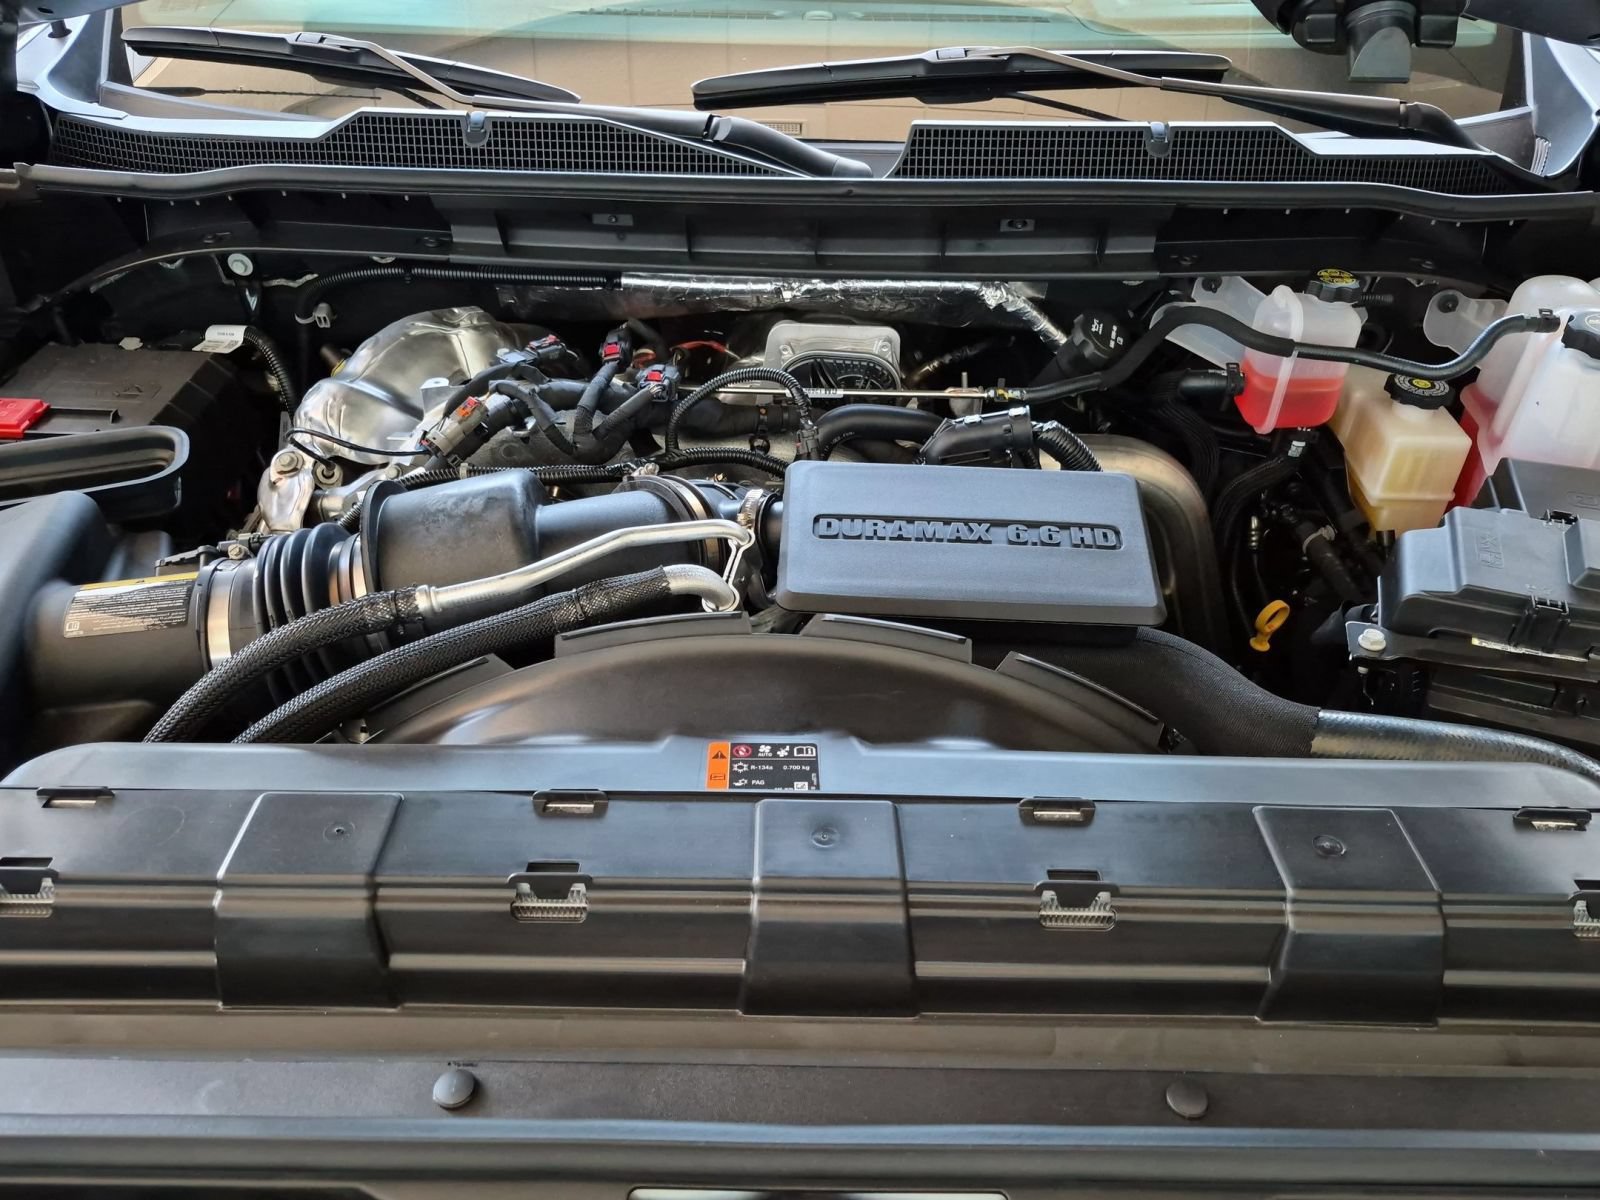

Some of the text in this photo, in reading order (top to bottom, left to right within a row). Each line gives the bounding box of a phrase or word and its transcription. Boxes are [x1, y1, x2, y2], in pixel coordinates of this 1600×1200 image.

[817, 518, 1118, 549] DURAMAX 6.6 HD
